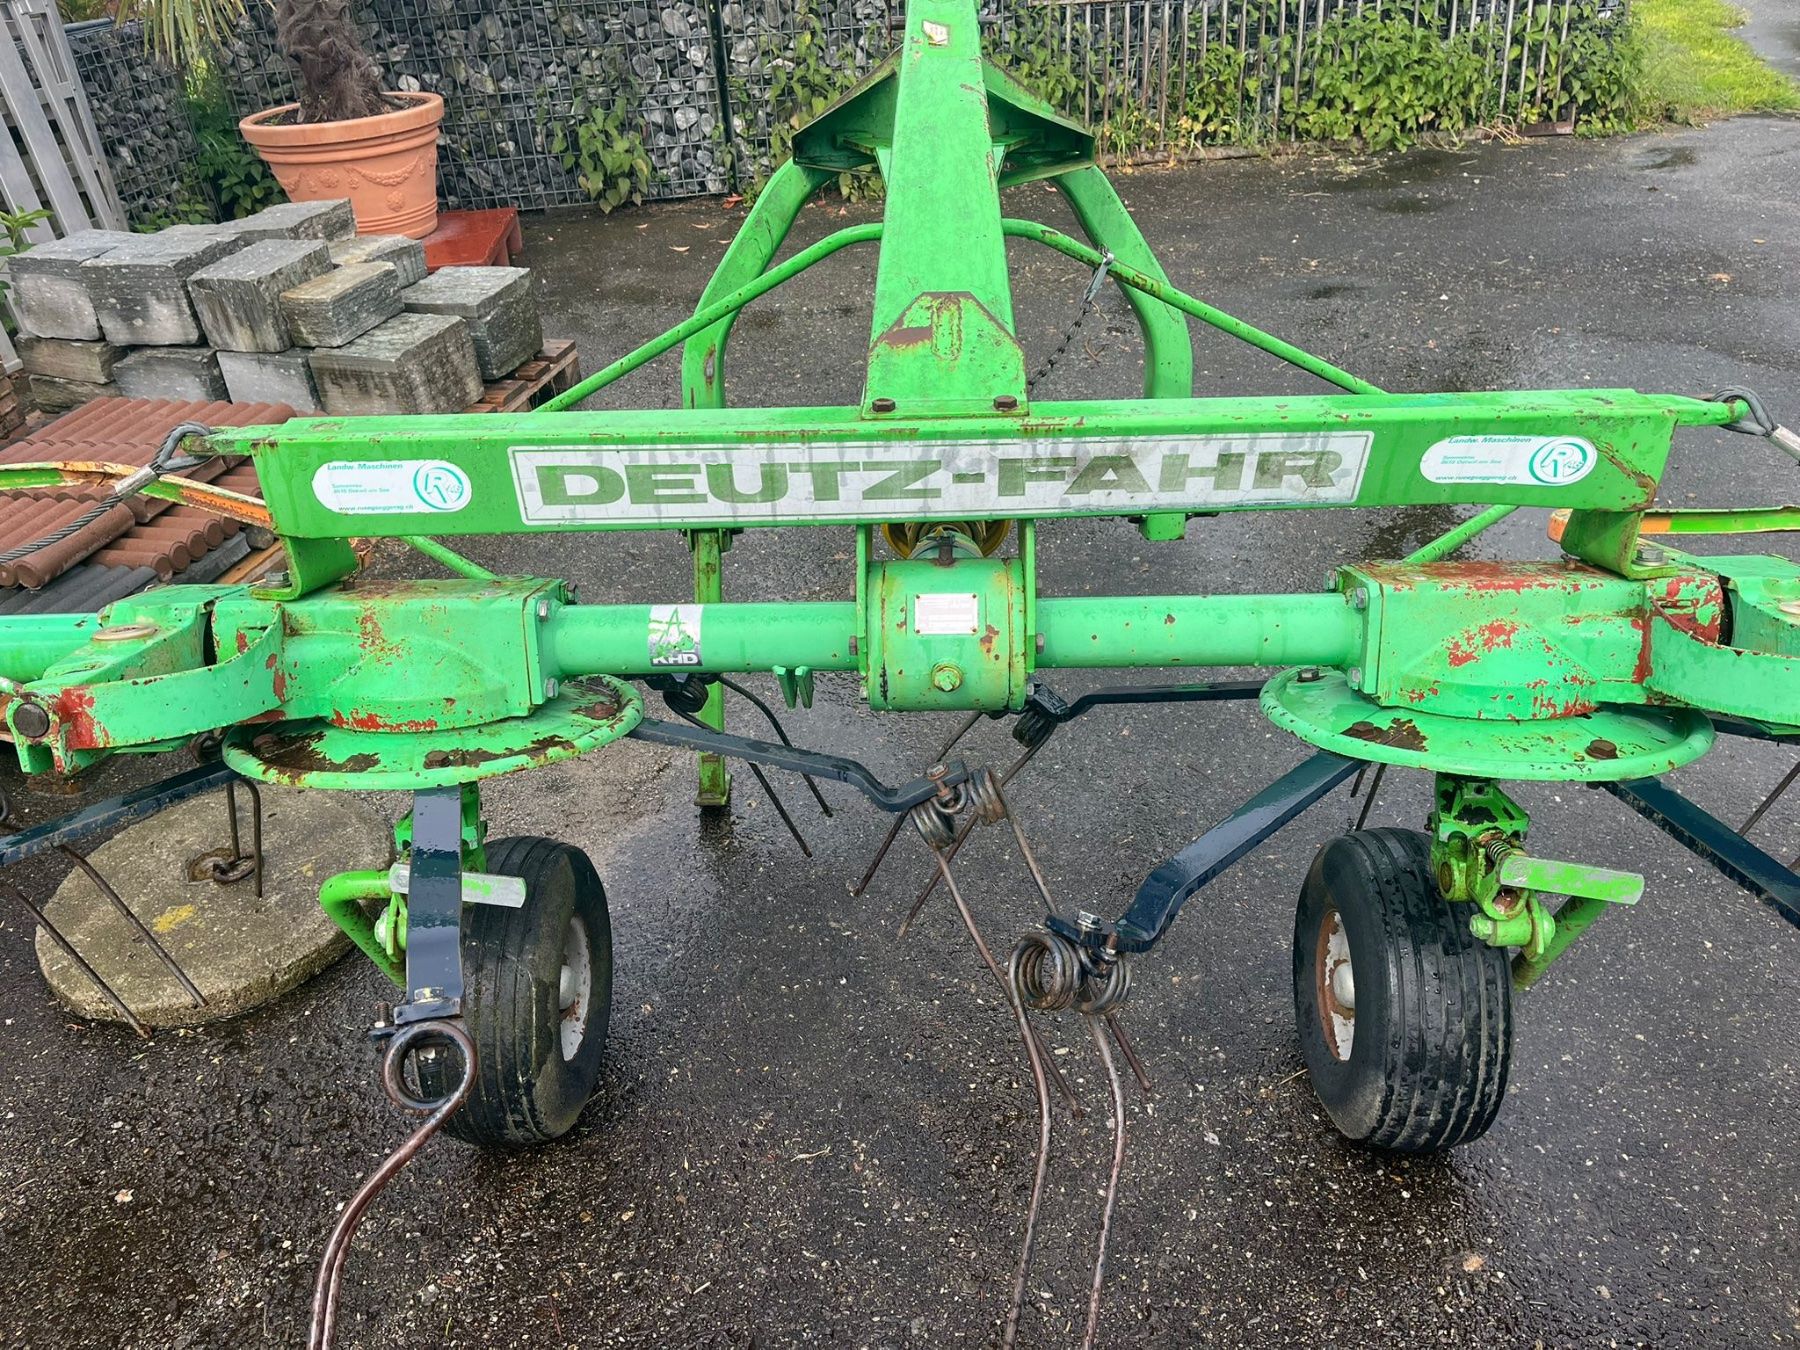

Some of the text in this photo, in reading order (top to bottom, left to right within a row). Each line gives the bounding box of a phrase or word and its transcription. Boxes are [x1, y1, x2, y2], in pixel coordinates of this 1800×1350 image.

[327, 463, 355, 471] Landw.
[534, 450, 1342, 507] DEUTZ-FAHR
[652, 652, 699, 664] KHD
